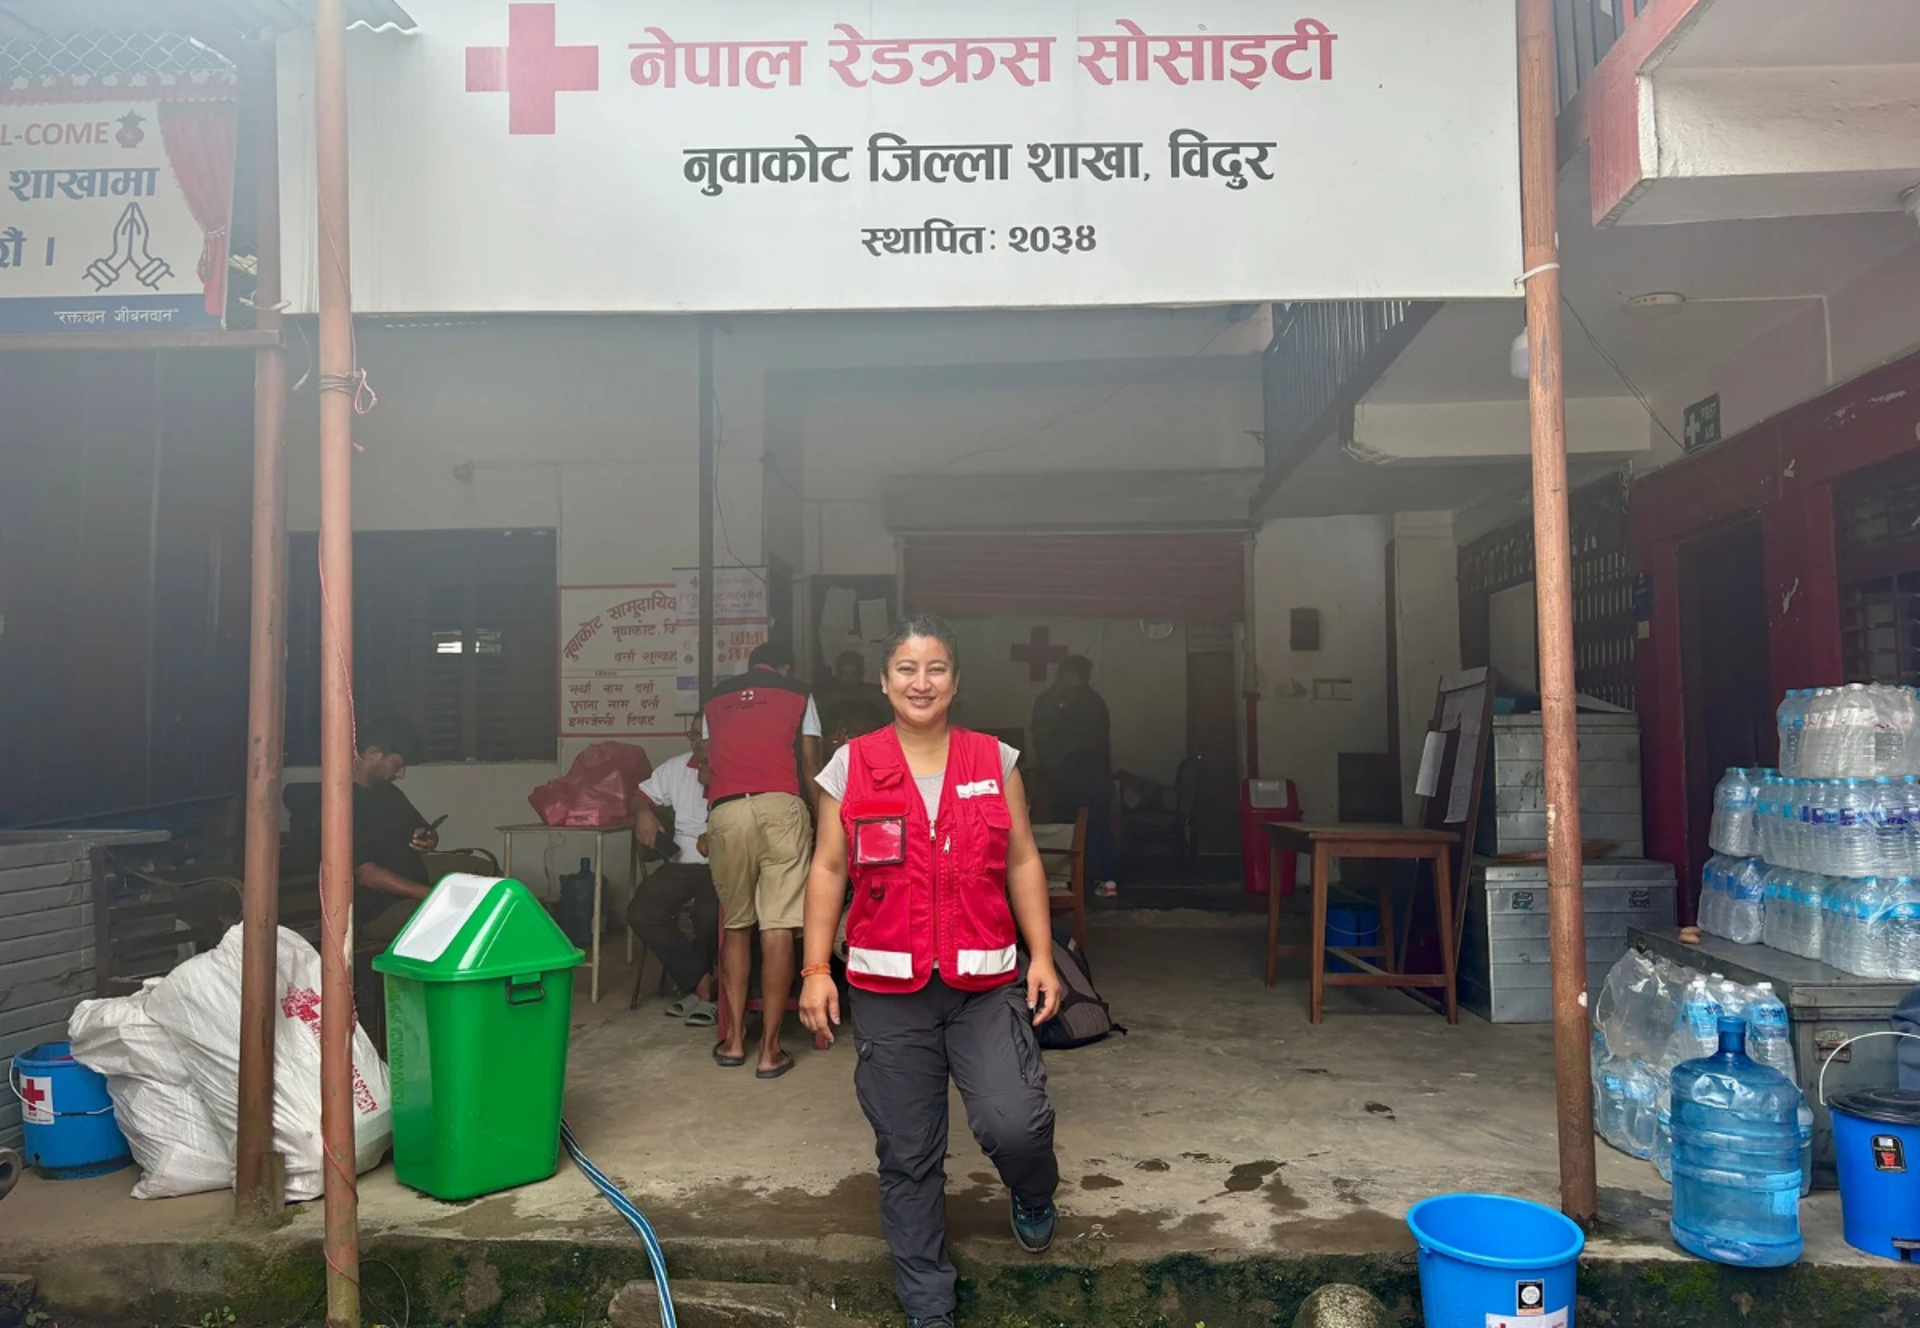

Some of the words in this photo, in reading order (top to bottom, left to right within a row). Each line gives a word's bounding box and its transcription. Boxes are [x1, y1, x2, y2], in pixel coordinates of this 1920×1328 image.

[628, 26, 808, 89] नेपाल
[828, 23, 1057, 87] रेडक्रस
[1077, 17, 1338, 90] सोसाइटी
[683, 134, 853, 196] नुवाकोट
[867, 132, 1013, 183] जिल्ला
[1026, 142, 1150, 182] शाखा,
[1168, 128, 1277, 190] विदुर
[9, 167, 160, 201] शाखामा
[1008, 225, 1097, 254] २०३४
[563, 615, 603, 663] नुवाकोट
[607, 699, 630, 711] नाम
